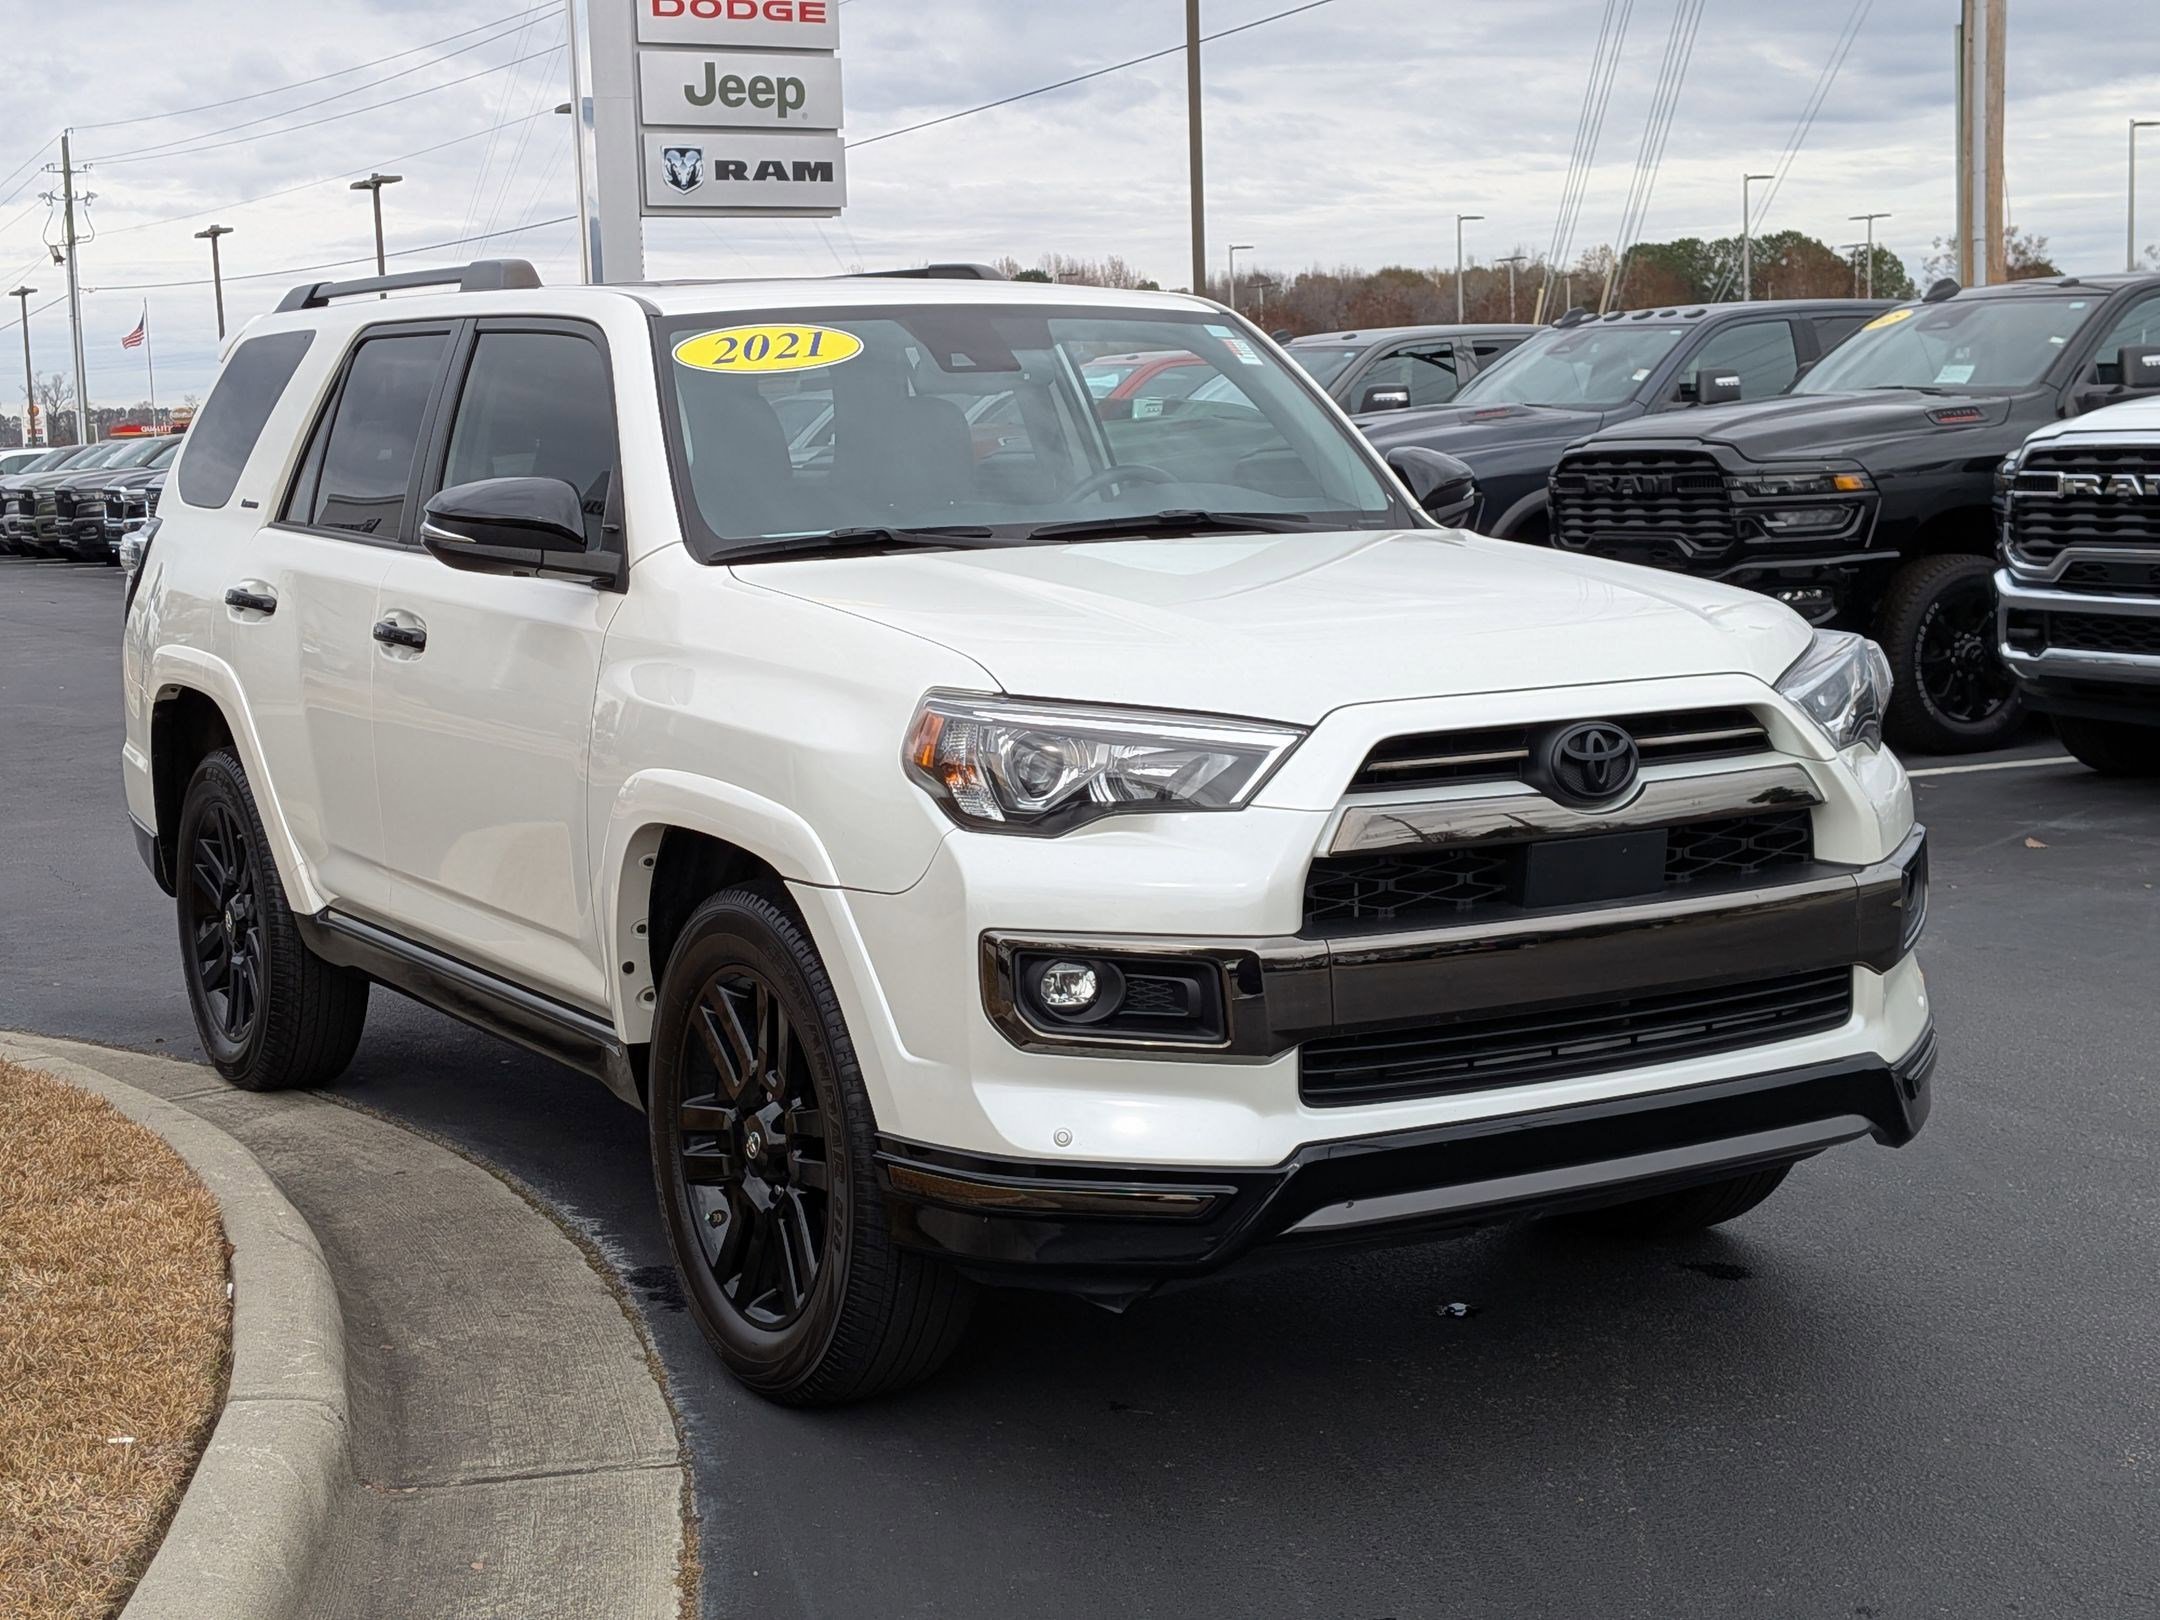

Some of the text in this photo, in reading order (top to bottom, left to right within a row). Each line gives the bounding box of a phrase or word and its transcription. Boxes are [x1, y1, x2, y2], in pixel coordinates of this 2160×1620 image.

[652, 0, 827, 24] DODGE
[684, 61, 806, 119] Jeep
[714, 159, 834, 182] RAM
[711, 330, 824, 365] 2021
[1585, 474, 1673, 494] RAM
